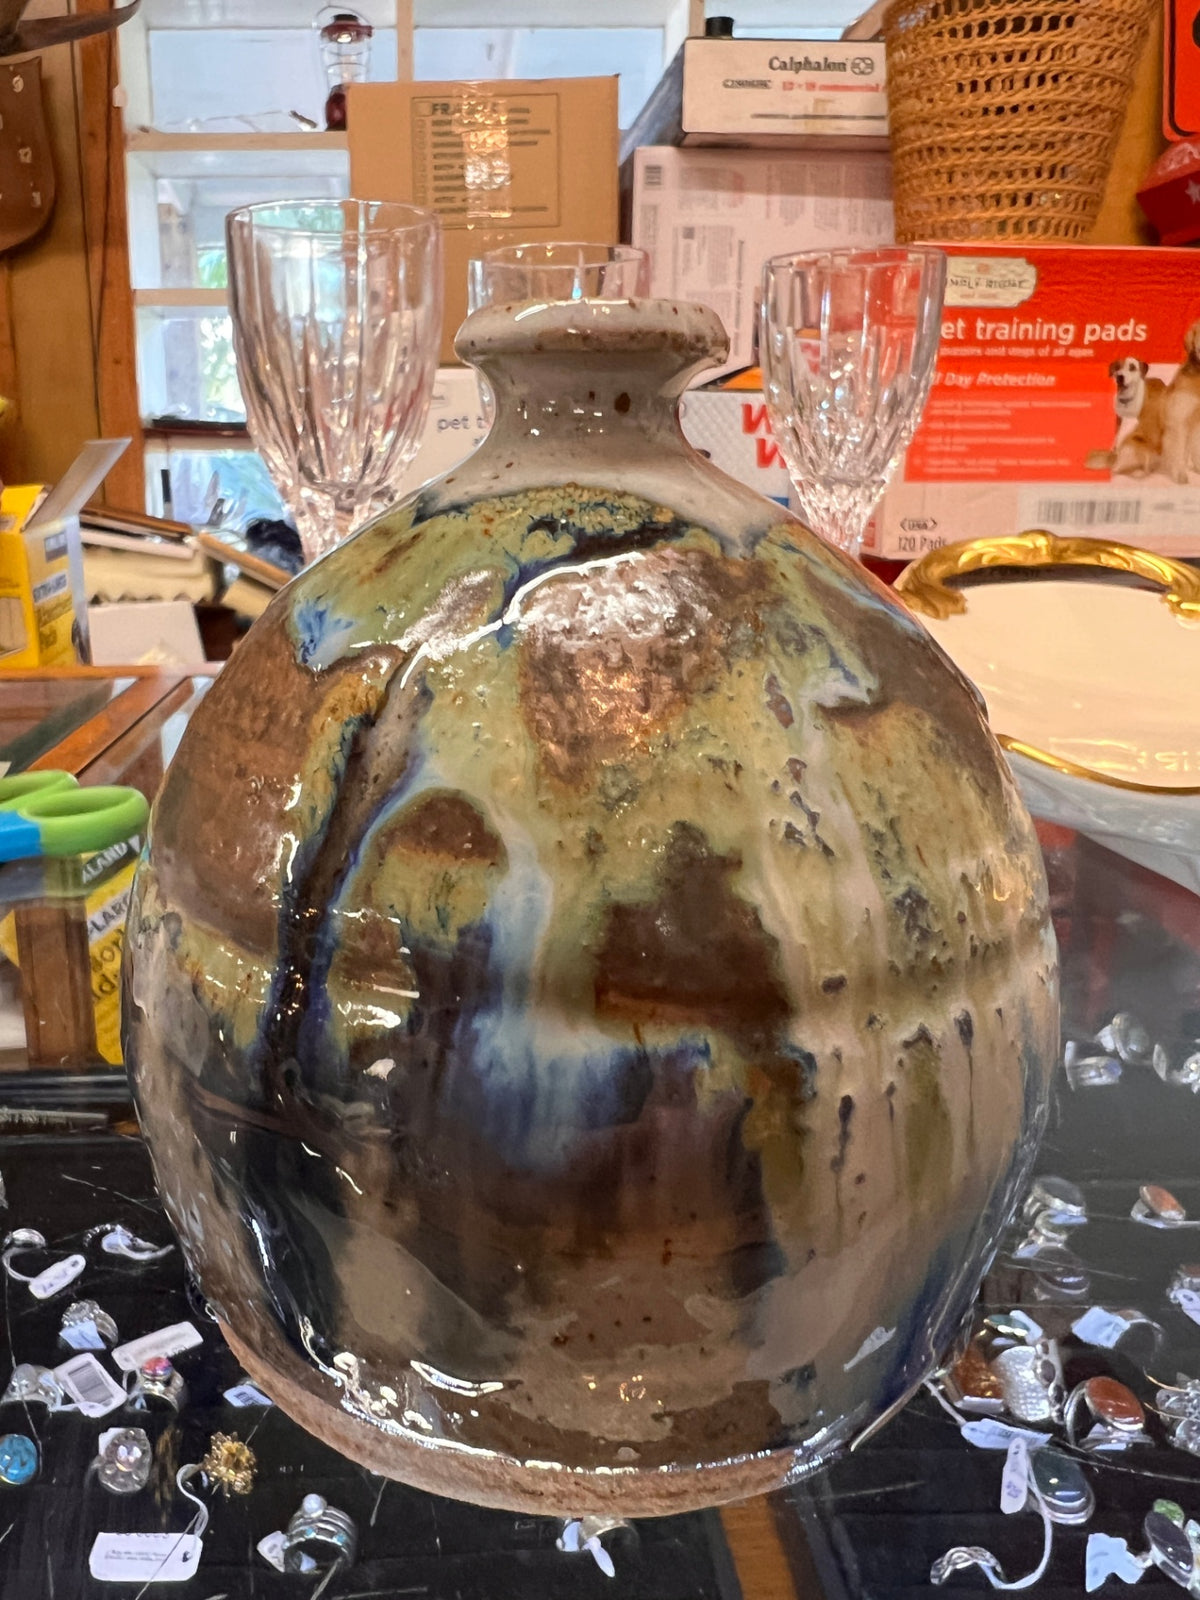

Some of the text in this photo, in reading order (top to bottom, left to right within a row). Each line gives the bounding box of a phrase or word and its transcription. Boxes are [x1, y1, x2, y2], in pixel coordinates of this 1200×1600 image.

[768, 56, 847, 74] Calphalon
[940, 317, 1148, 345] et training pads
[437, 416, 470, 433] pet
